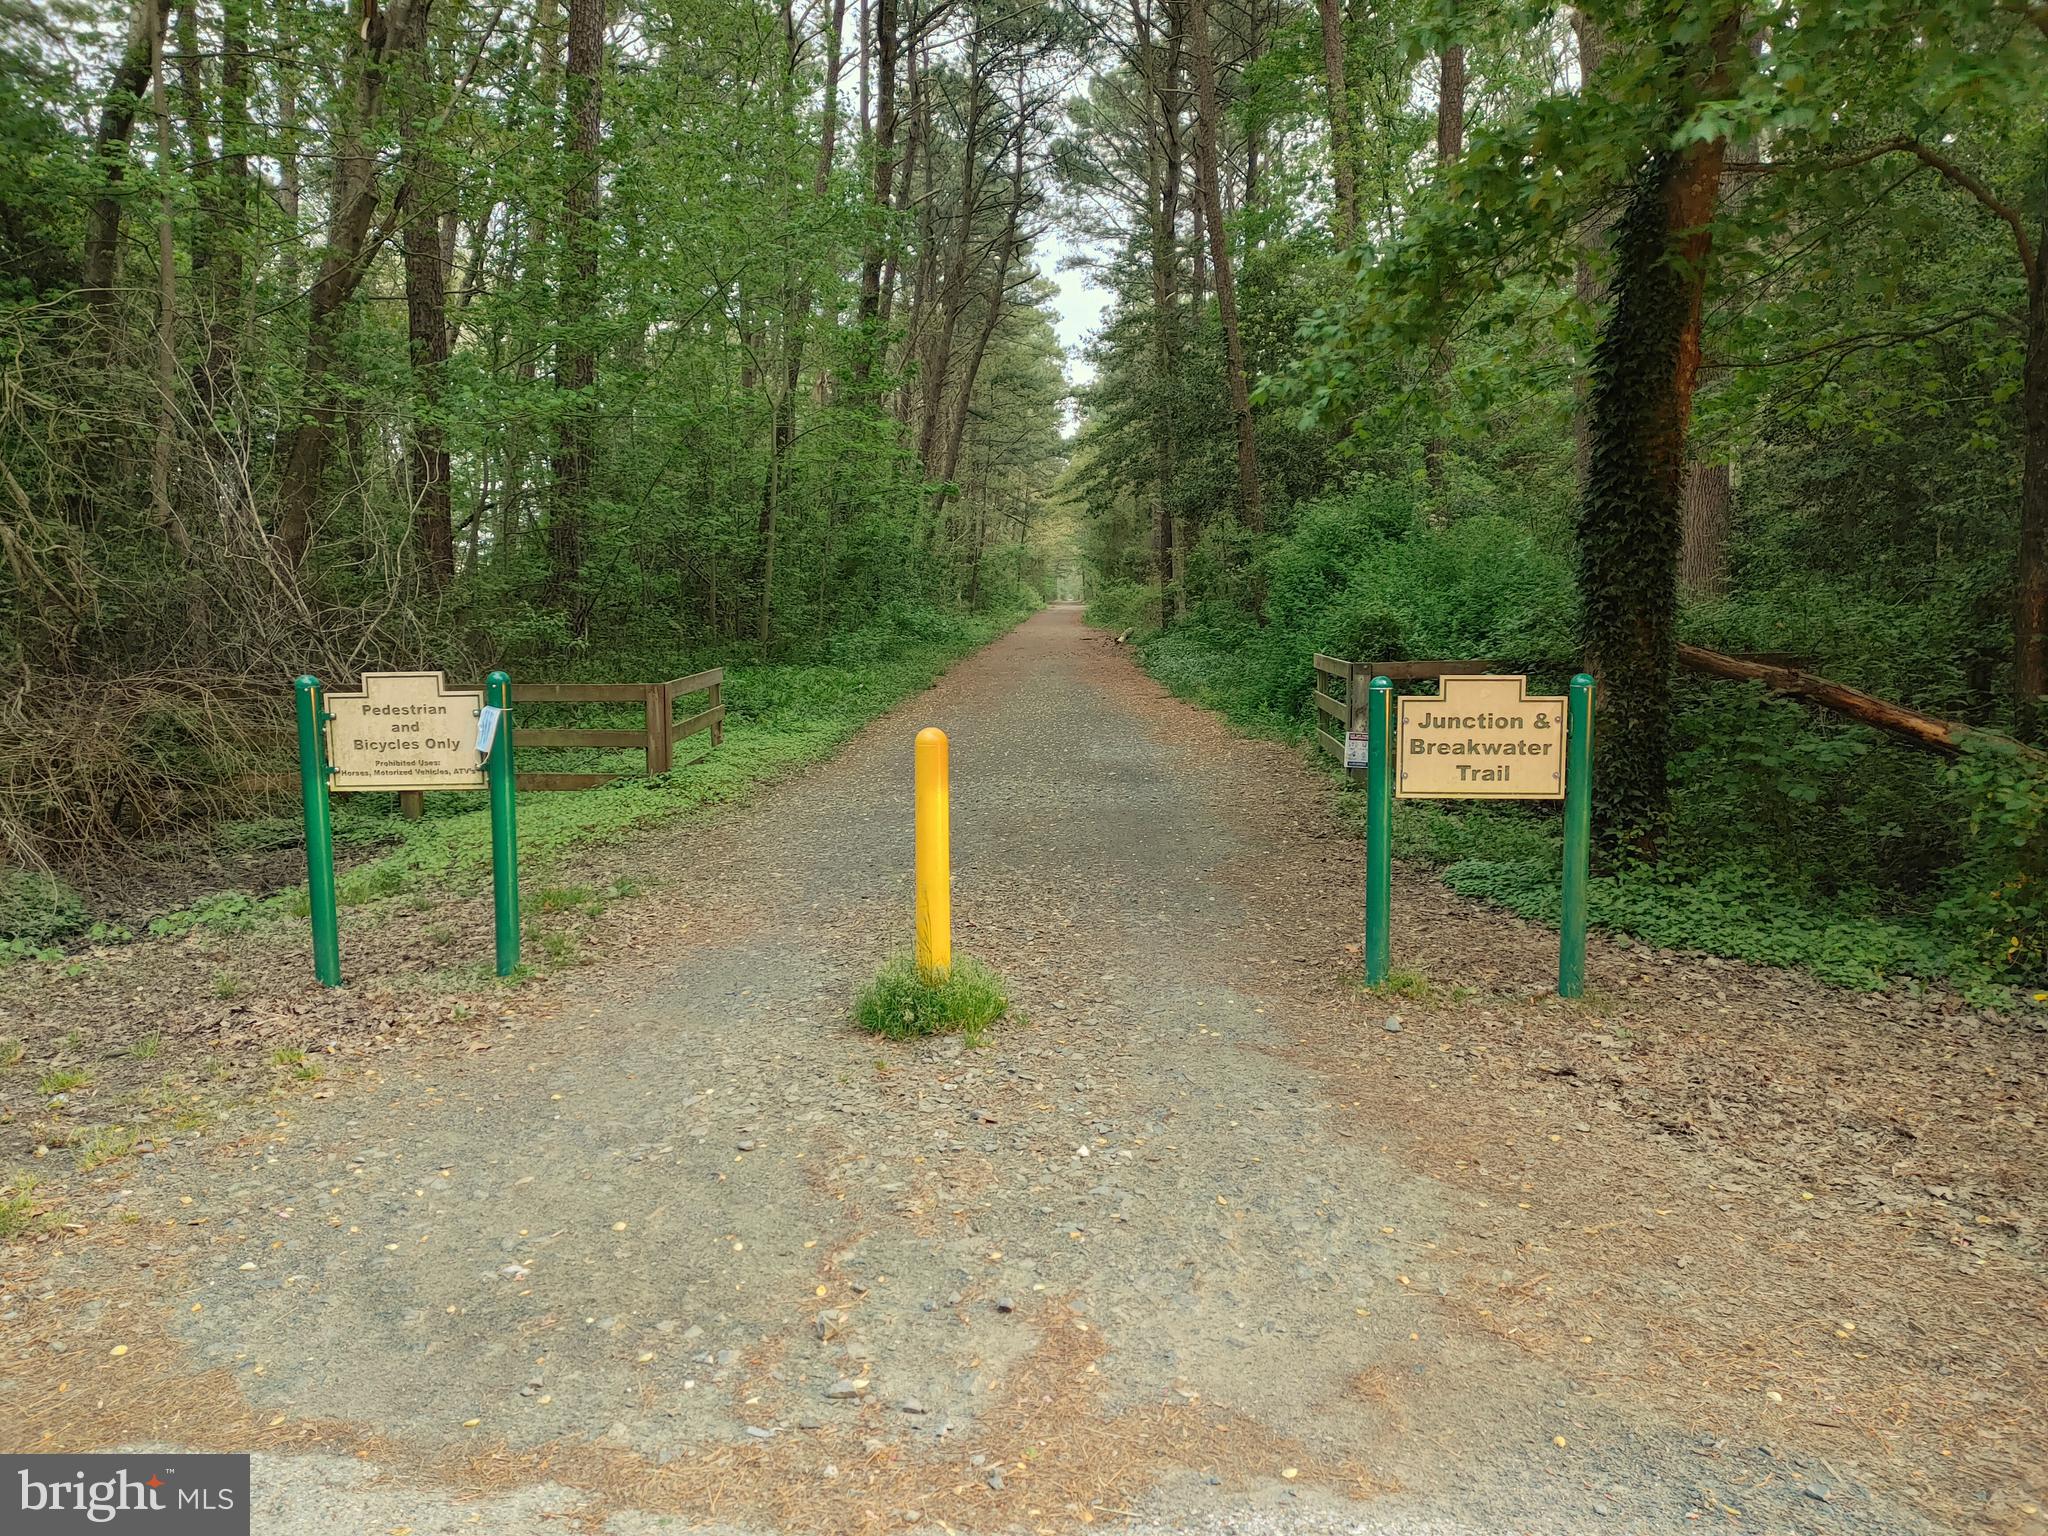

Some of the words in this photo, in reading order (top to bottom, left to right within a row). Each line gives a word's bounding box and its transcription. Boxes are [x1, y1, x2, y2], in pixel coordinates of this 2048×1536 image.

[362, 704, 447, 716] Pedestrian
[391, 721, 420, 733] and
[1418, 712, 1524, 729] Junction
[1533, 712, 1551, 729] &
[353, 739, 420, 752] Bicycles
[425, 738, 461, 751] Only
[1410, 738, 1552, 756] Breakwater
[418, 759, 441, 767] Uses:
[341, 769, 372, 777] Horses,
[374, 769, 413, 777] Motorized
[415, 768, 452, 776] Vehicles,
[1456, 765, 1510, 781] Trail
